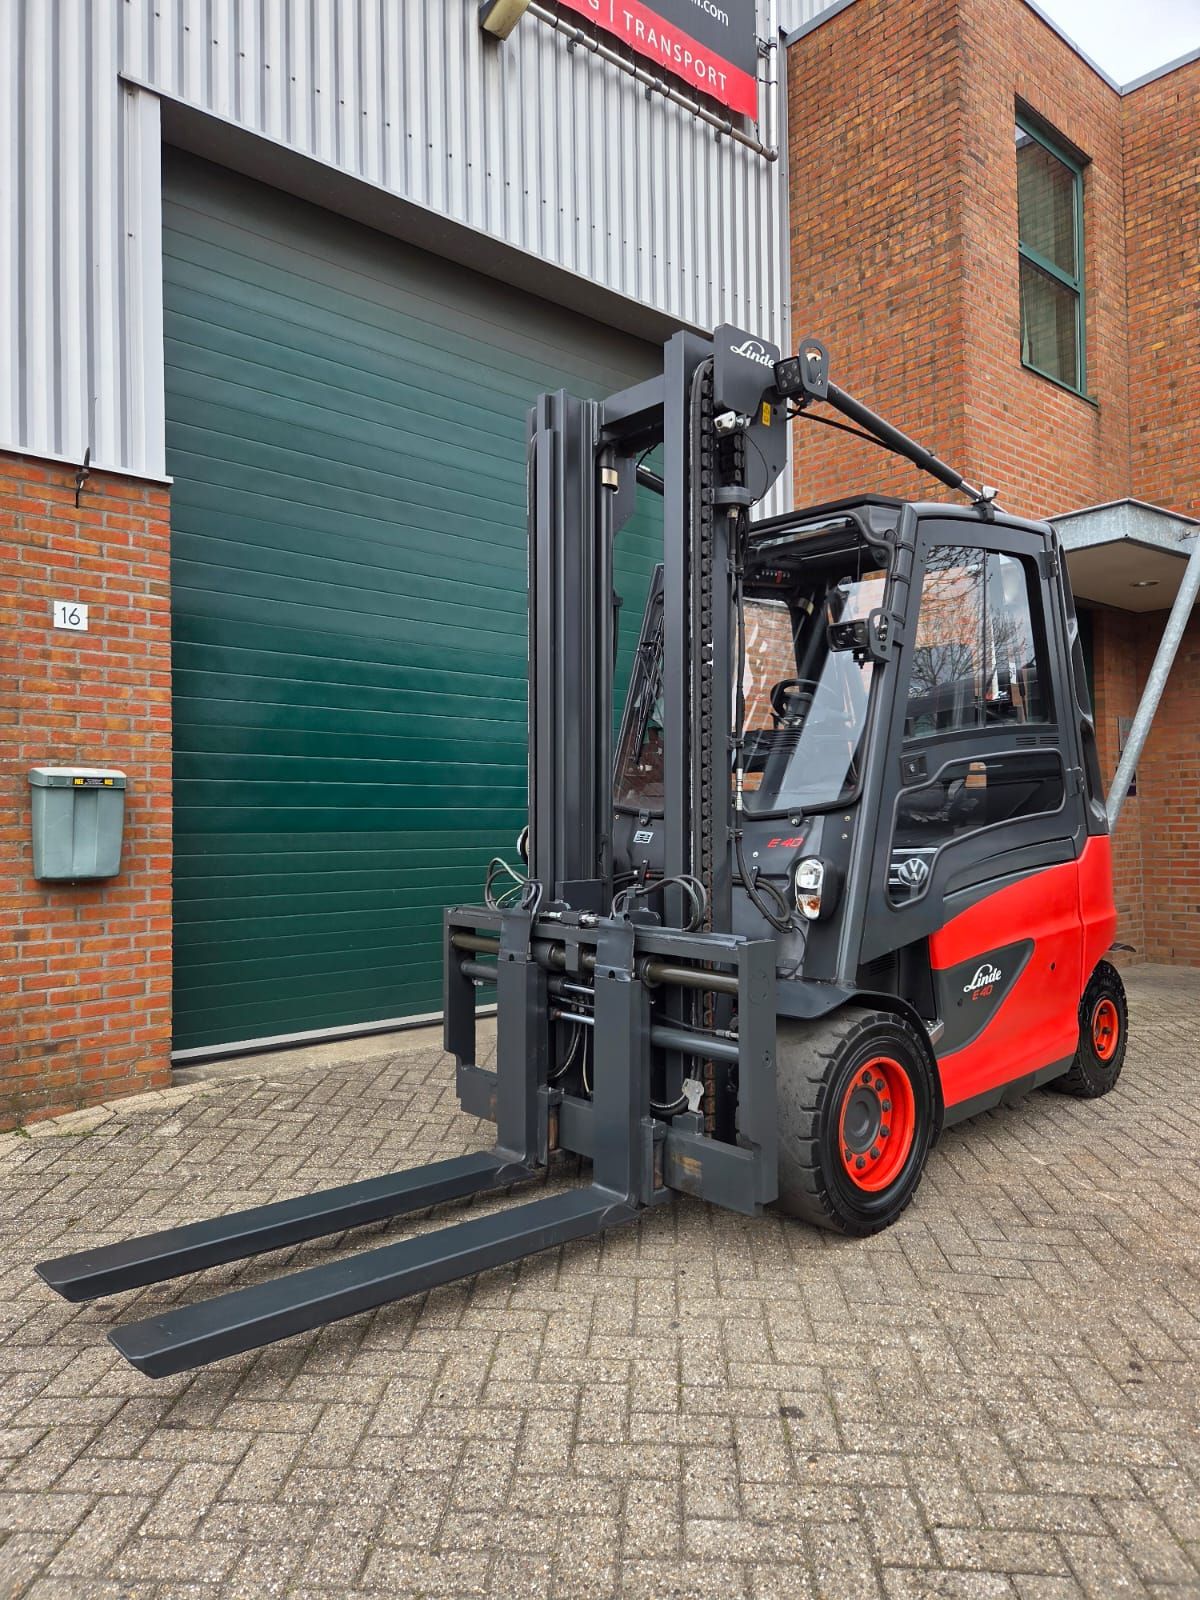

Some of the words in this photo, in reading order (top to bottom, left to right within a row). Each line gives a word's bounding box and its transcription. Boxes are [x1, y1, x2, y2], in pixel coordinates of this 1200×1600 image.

[623, 10, 727, 91] TRANSPORT
[730, 340, 775, 369] Linde
[61, 606, 81, 626] 16
[963, 963, 1002, 993] Linde
